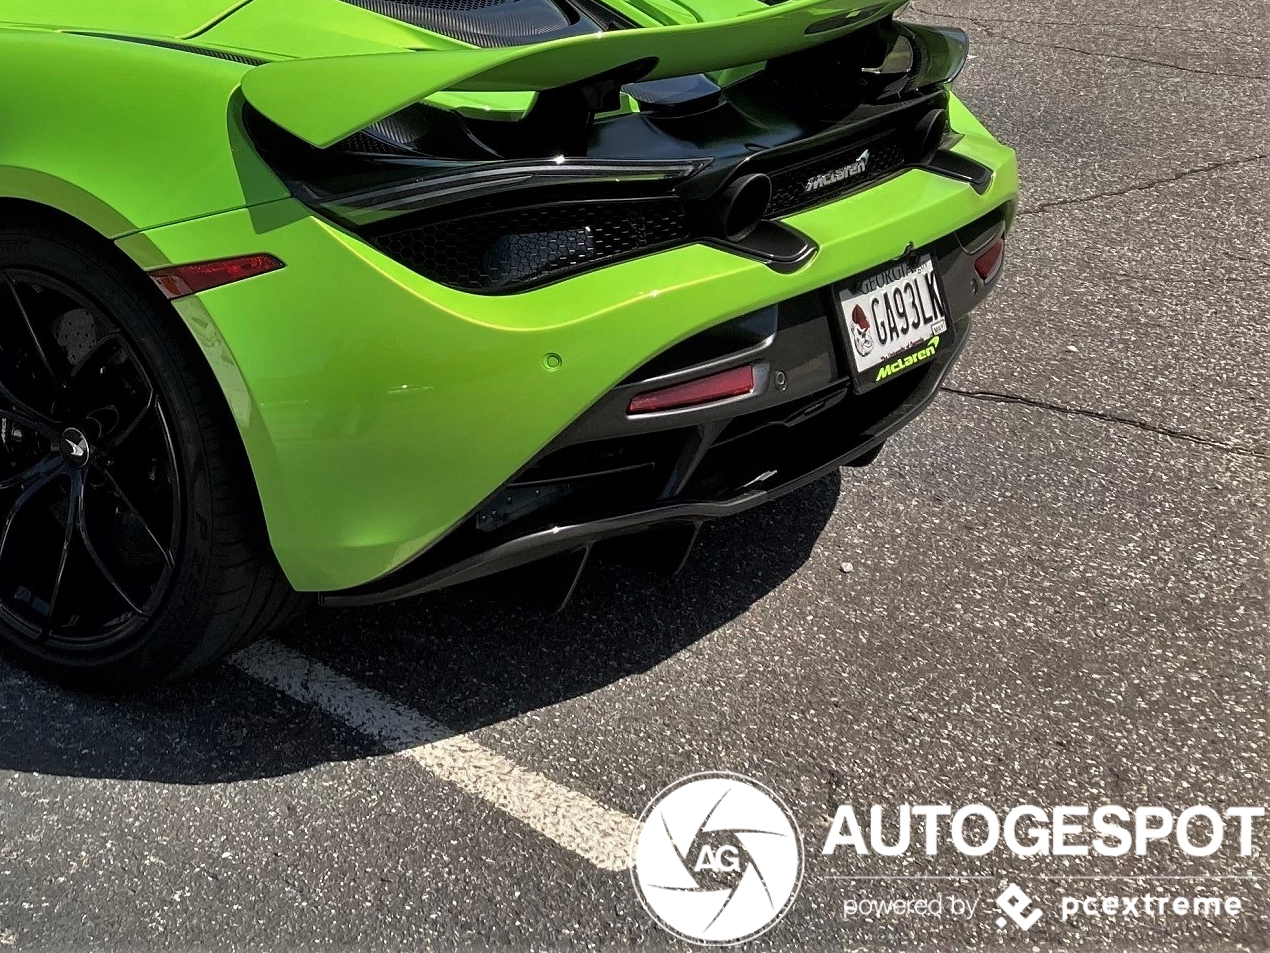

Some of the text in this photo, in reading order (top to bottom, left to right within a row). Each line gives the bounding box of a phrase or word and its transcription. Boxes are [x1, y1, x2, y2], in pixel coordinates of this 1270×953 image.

[804, 159, 867, 192] McLaren
[871, 270, 946, 345] GA93LK
[875, 346, 936, 382] McLaren
